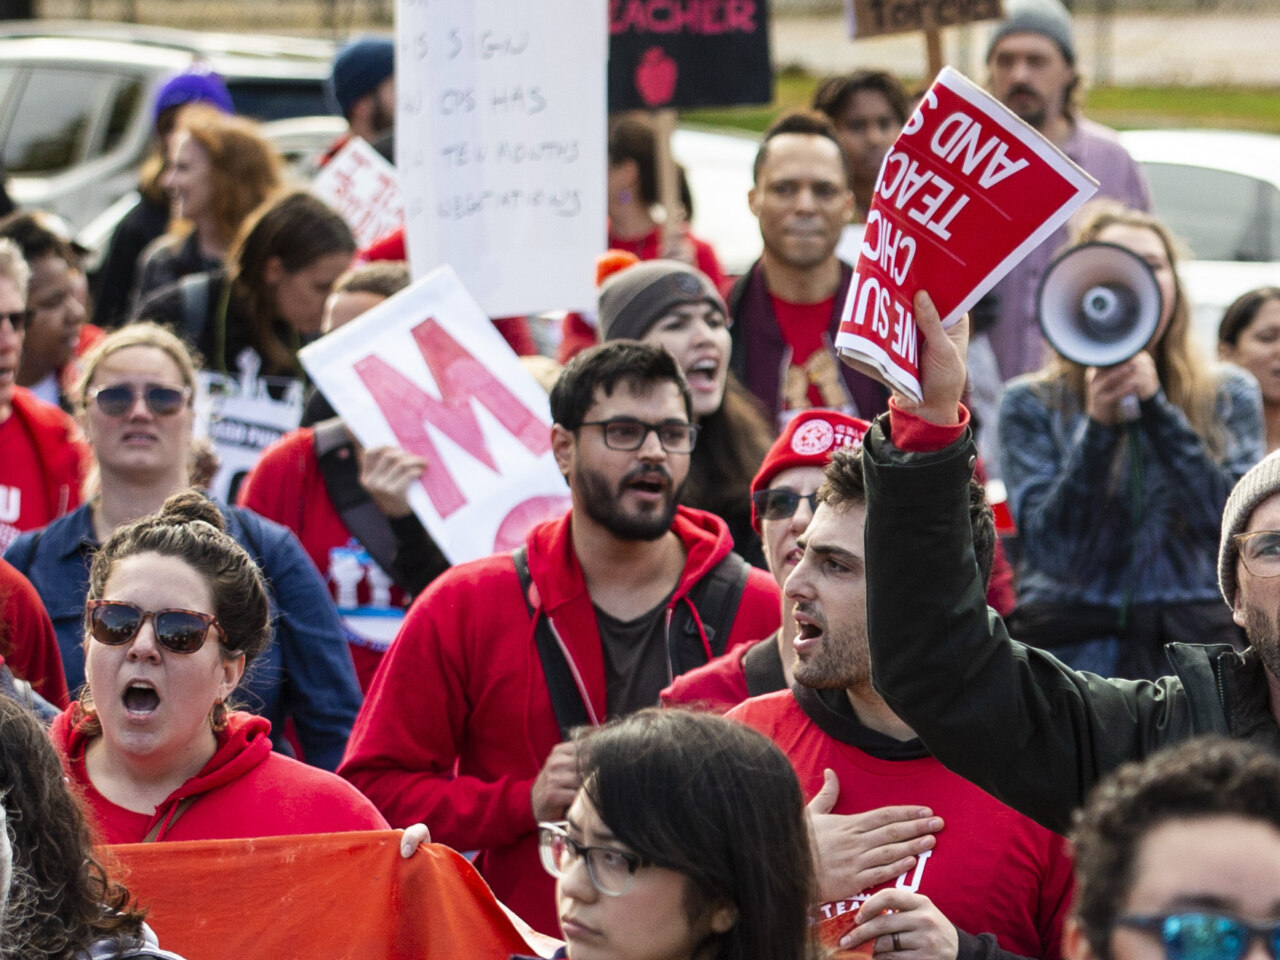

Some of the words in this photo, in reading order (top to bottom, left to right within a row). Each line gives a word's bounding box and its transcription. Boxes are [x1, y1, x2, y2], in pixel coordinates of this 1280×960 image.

[446, 27, 530, 60] SGN
[930, 111, 1031, 190] AND
[875, 145, 971, 242] TEAC
